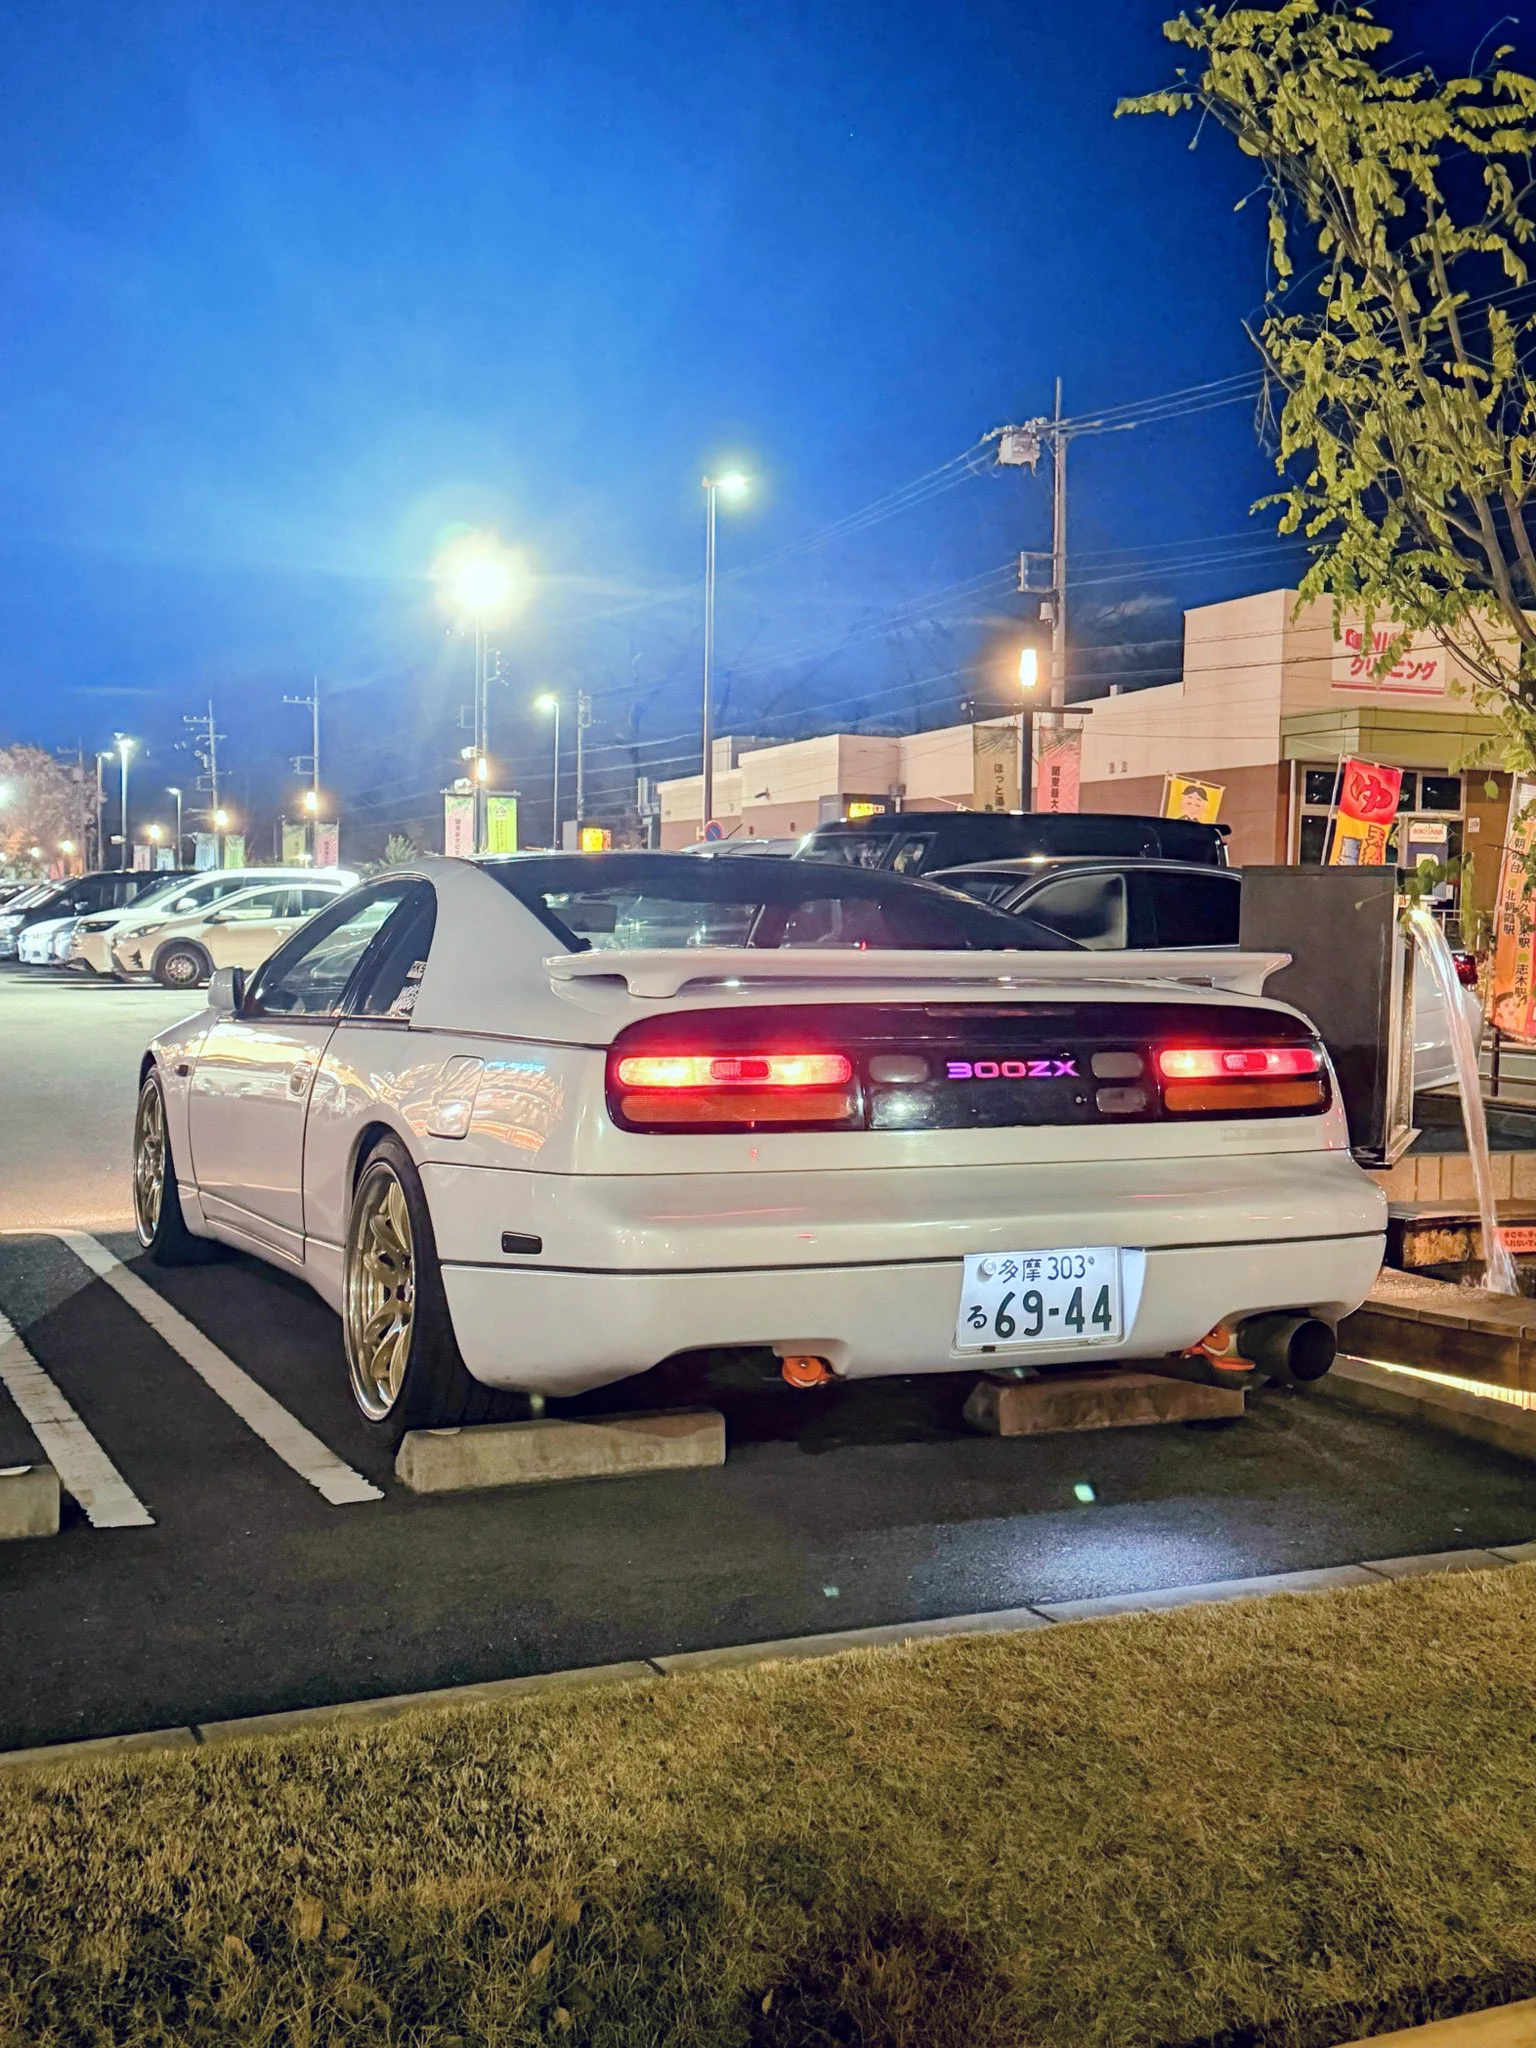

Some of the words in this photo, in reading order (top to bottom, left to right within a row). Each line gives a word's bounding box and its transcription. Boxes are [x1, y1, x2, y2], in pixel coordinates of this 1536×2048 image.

[1350, 657, 1437, 680] クリニング
[1050, 765, 1061, 813] 関東最大
[1350, 771, 1393, 814] ゆ
[946, 1060, 1080, 1079] 300ZX
[998, 1258, 1042, 1283] 多摩
[1047, 1255, 1086, 1280] 303
[967, 1305, 988, 1329] る
[994, 1284, 1112, 1339] 69-44
